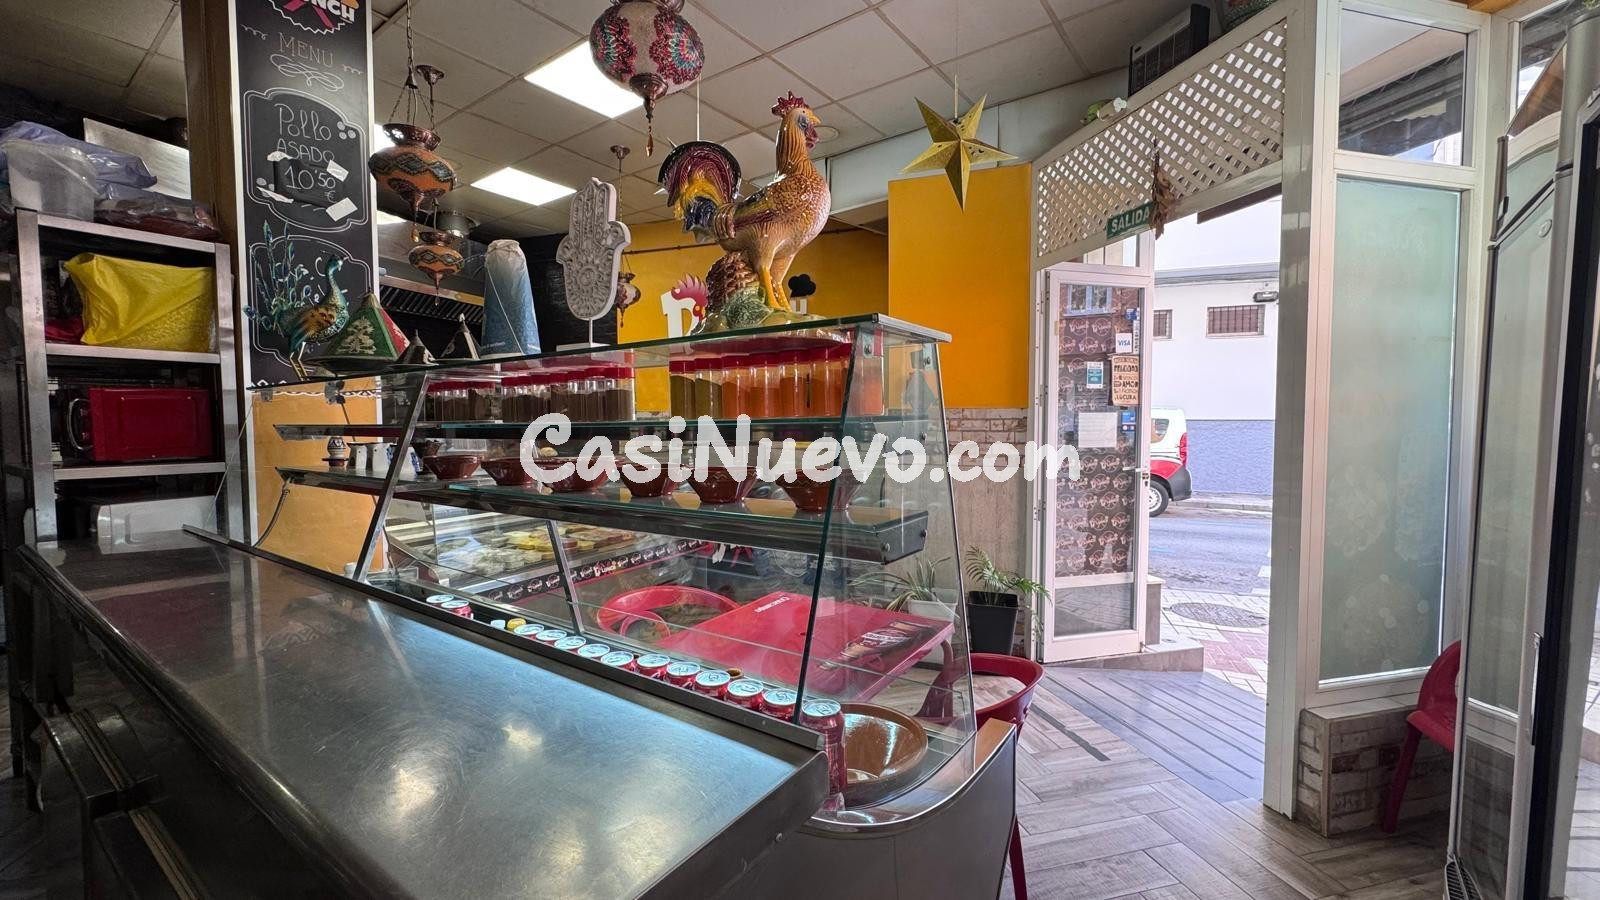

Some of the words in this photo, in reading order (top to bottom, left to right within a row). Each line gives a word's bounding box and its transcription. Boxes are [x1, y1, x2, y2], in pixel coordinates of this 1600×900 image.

[278, 32, 334, 68] MENU
[276, 138, 335, 163] ASADO
[1111, 206, 1151, 233] SALIDA
